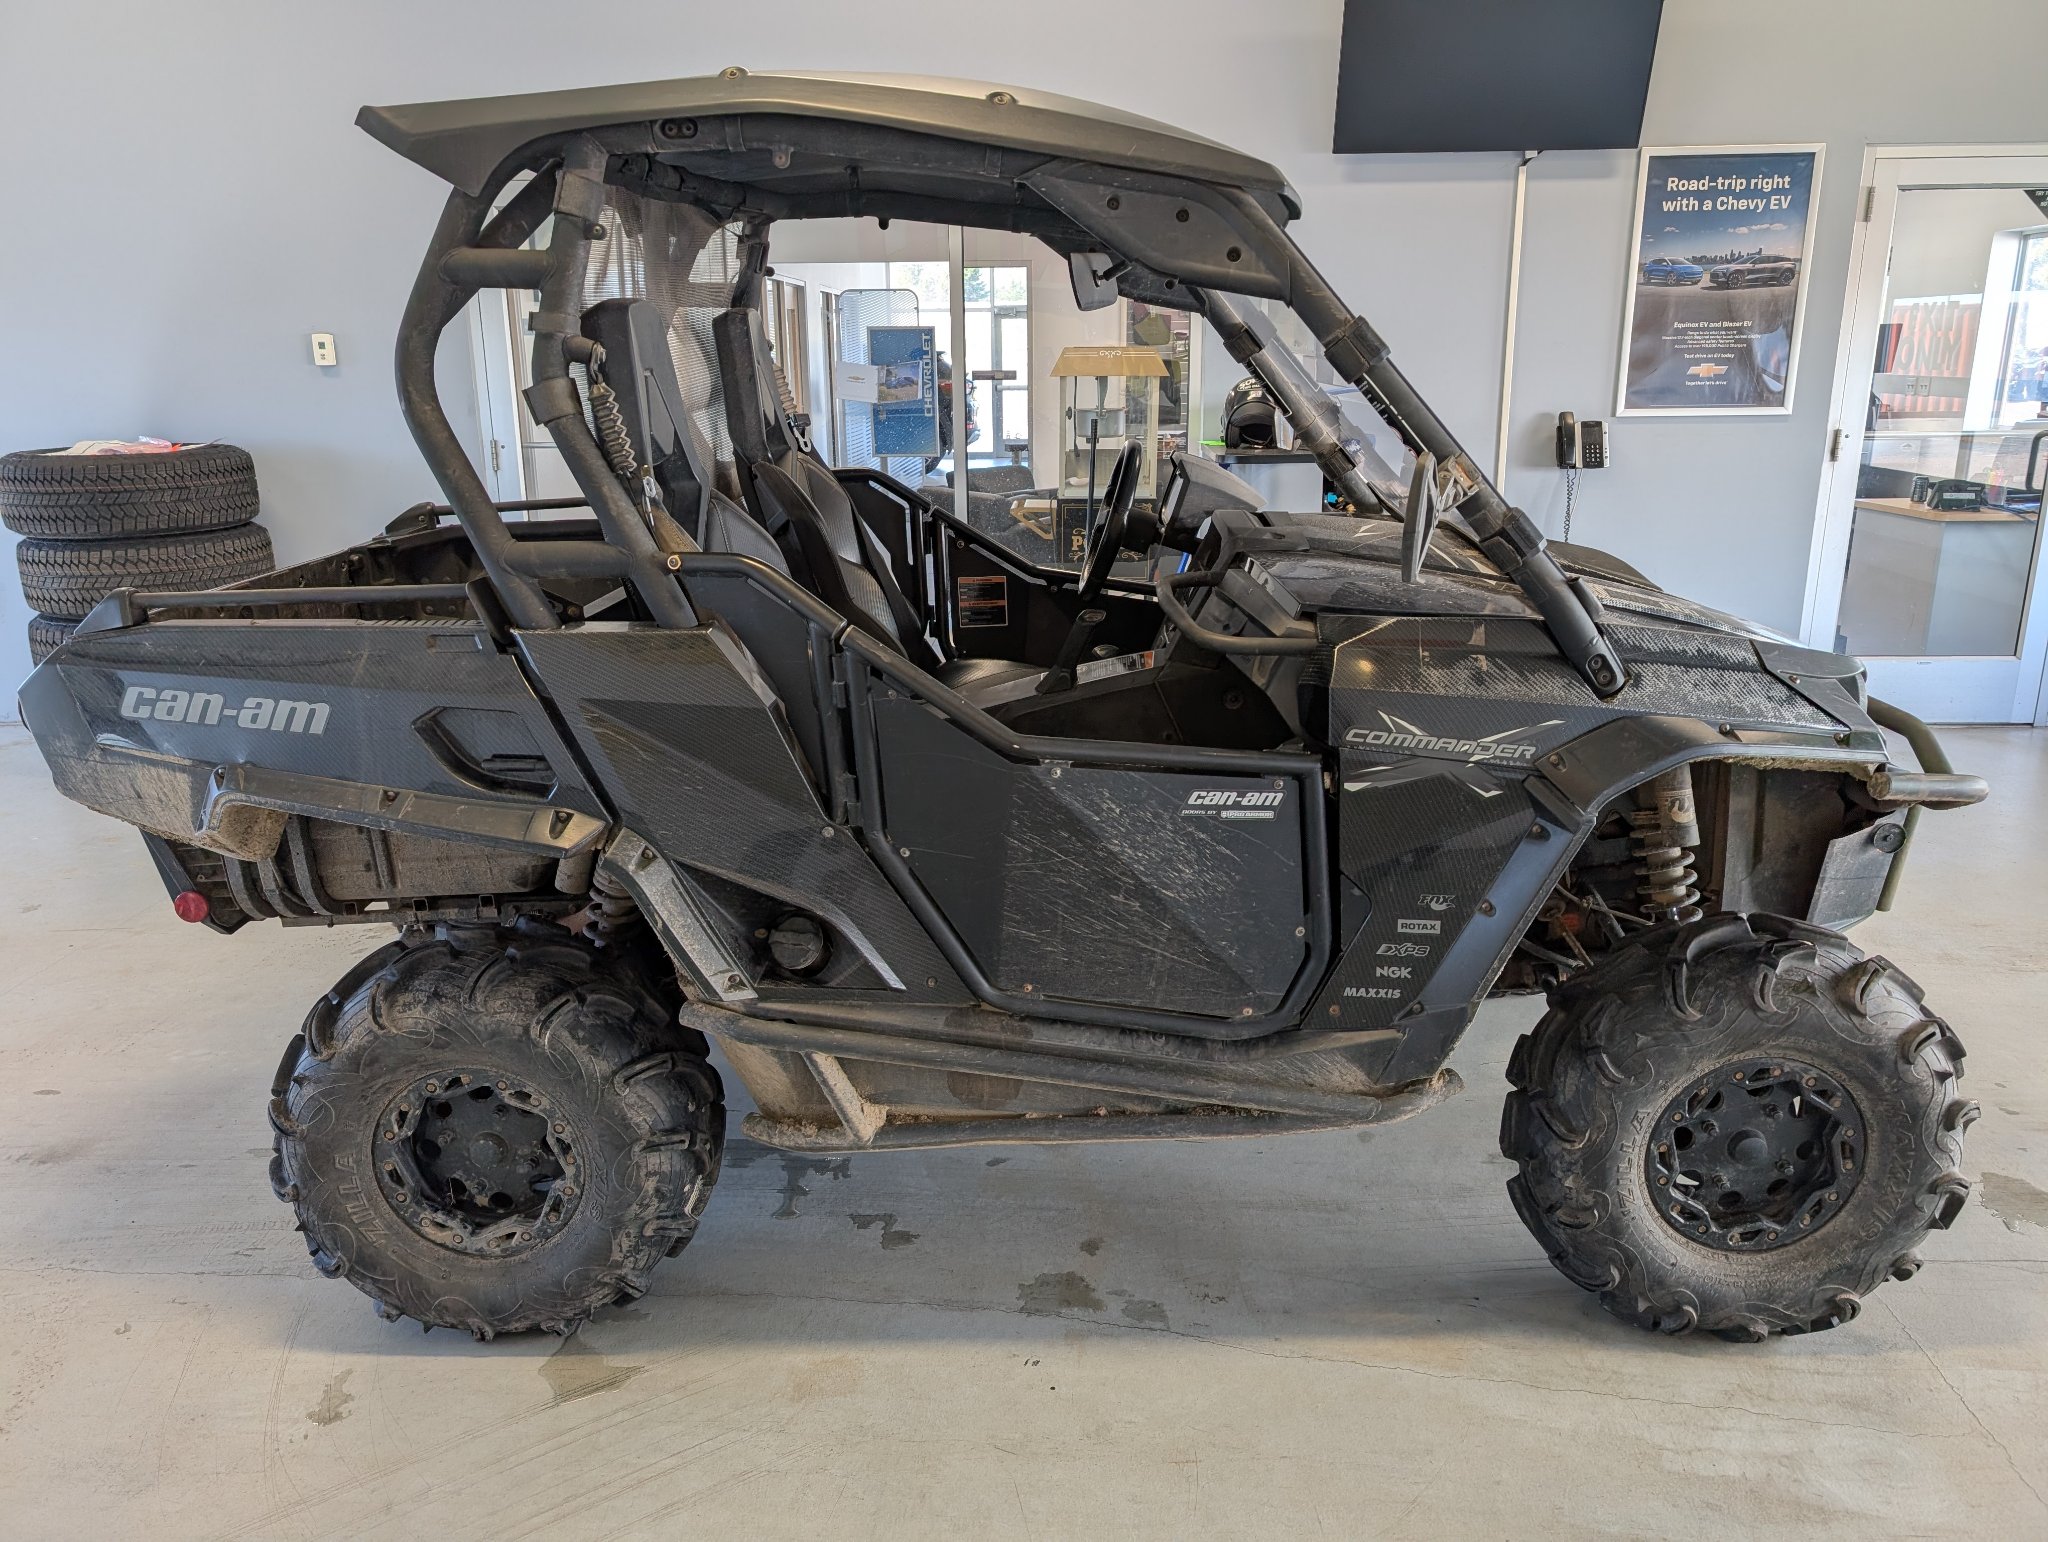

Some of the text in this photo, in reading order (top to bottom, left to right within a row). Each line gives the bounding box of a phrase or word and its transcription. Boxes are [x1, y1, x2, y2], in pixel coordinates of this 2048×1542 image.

[1667, 174, 1791, 192] Road-trip right
[1662, 195, 1792, 213] with a Chevy EV
[1674, 321, 1699, 329] Equinox
[922, 333, 933, 417] CHEVROLET
[120, 686, 330, 736] can-am
[1345, 728, 1537, 760] COMMANDER
[1187, 791, 1284, 806] can-am
[1418, 894, 1456, 909] FOX
[1400, 922, 1438, 931] ROTAX
[1390, 942, 1431, 957] XPS
[1375, 965, 1412, 979] NGK
[1343, 986, 1402, 999] MAXXIS
